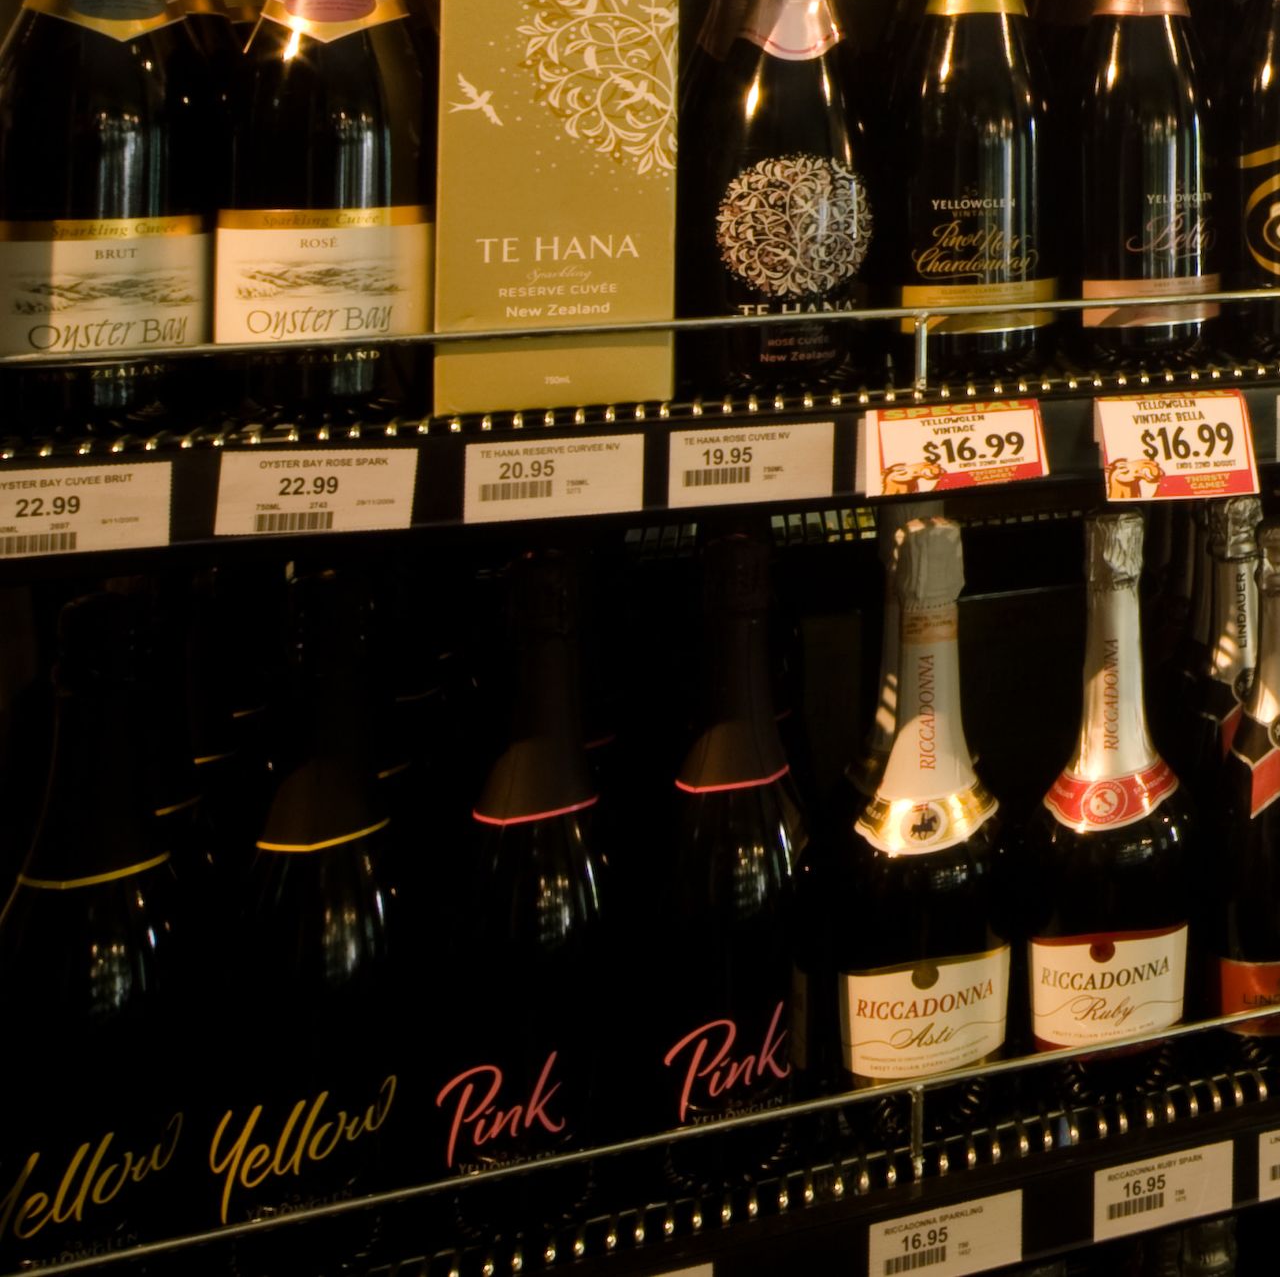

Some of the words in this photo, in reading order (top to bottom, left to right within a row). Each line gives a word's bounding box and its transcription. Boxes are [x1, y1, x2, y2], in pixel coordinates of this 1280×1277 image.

[932, 197, 1016, 210] YELLOWGLEN
[1147, 192, 1212, 205] YELLOWGLEN
[300, 236, 338, 249] ROSÉ
[933, 221, 981, 249] Pinot
[95, 248, 138, 261] BRUT
[476, 238, 520, 264] TE
[535, 235, 640, 261] HANA
[526, 266, 592, 285] Sparkling
[499, 284, 566, 298] RESERVE
[570, 282, 617, 295] CUVÉE
[506, 304, 542, 318] New
[547, 302, 610, 316] Zealand
[28, 318, 139, 351] Oyster
[139, 315, 189, 348] Bay
[246, 307, 341, 340] Oyster
[343, 304, 392, 333] Bay
[883, 401, 1028, 419] SPECIAL
[1136, 400, 1196, 410] YELLOWGLEN
[921, 414, 985, 426] YELLOWGLEN
[1132, 413, 1172, 425] VINTAGE
[1176, 411, 1205, 421] BELLA
[933, 425, 975, 435] VINTAGE
[1141, 422, 1234, 460] $16.99
[494, 449, 520, 458] HANA
[522, 447, 564, 456] RESERVE
[702, 447, 753, 466] 19.95
[923, 431, 1025, 465] $16.99
[259, 459, 299, 469] OYSTER
[302, 459, 322, 468] BAY
[325, 458, 350, 467] ROSE
[352, 457, 388, 467] SPARK
[499, 460, 555, 480] 20.95
[40, 479, 62, 488] BAY
[65, 475, 101, 486] CUVEE
[104, 474, 133, 483] BRUT
[279, 476, 339, 497] 22.99
[15, 496, 81, 518] 22.99
[1237, 572, 1246, 648] LINDAUER
[1103, 638, 1120, 751] RICCADONNA
[919, 654, 936, 770] RICCADONNA
[1040, 955, 1170, 991] RICCADONNA
[856, 978, 994, 1020] RICCADONNA
[1070, 995, 1138, 1031] Ruby
[889, 1022, 955, 1049] Asti
[664, 1001, 791, 1122] Pink
[436, 1051, 565, 1168] Pink
[209, 1075, 397, 1225] Yellow
[1123, 1174, 1166, 1198] 16.95
[901, 1227, 948, 1252] 16.95
